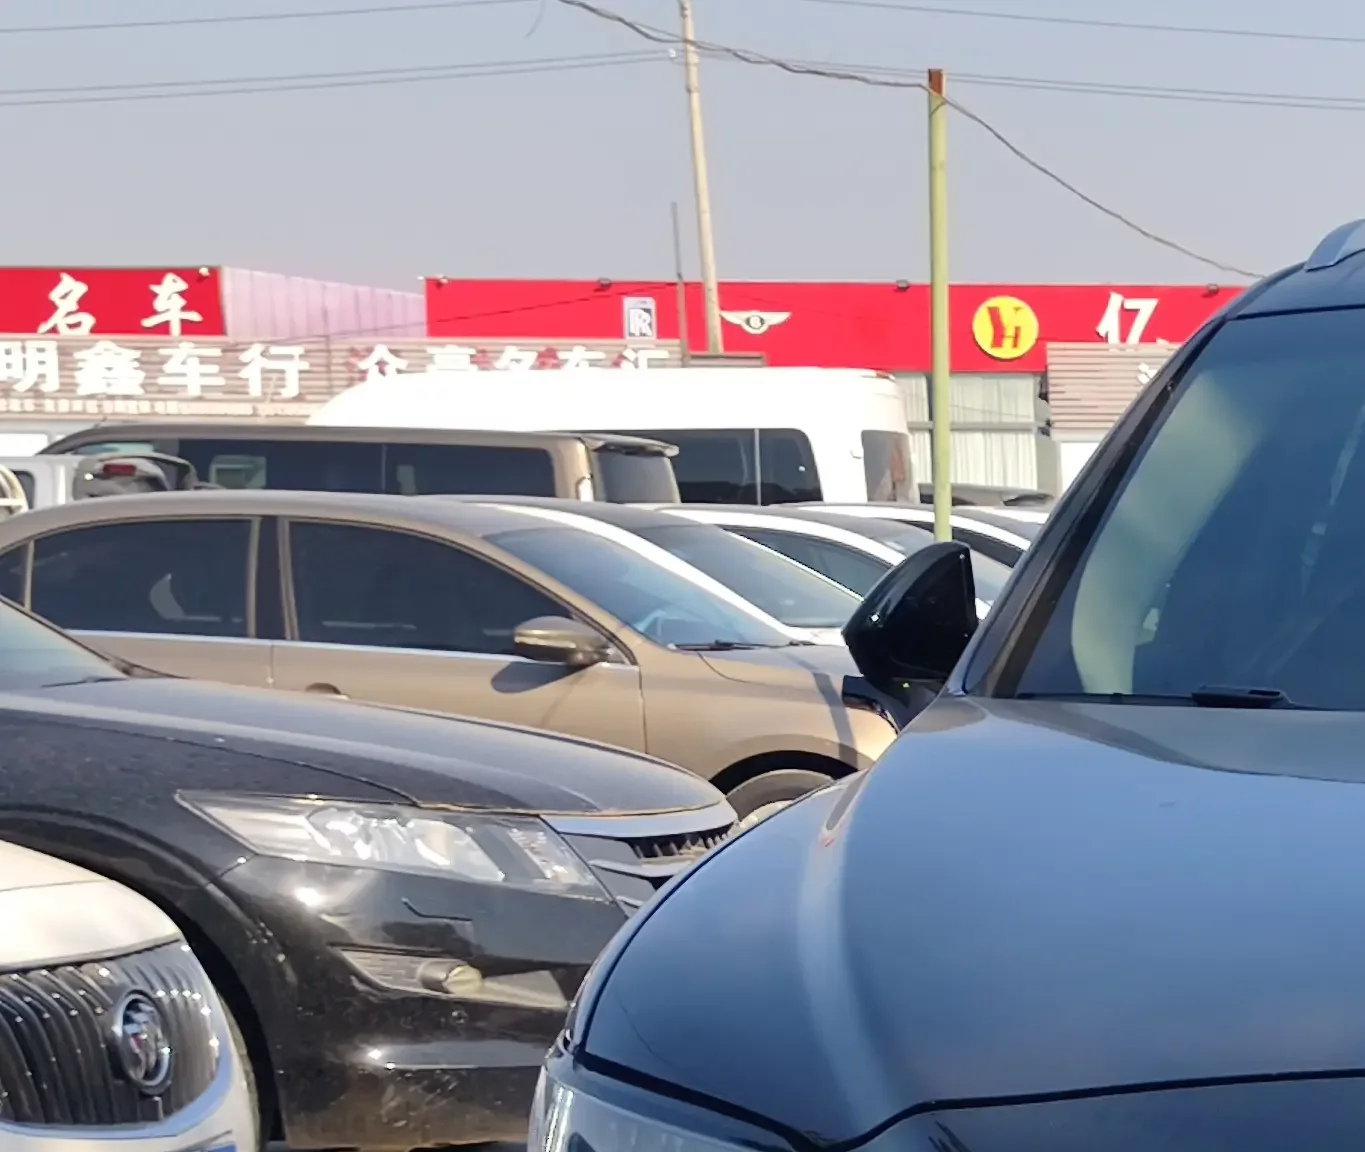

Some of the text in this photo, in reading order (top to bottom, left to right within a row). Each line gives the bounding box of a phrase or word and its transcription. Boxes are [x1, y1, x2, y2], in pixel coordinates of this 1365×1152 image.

[38, 273, 204, 336] 名车
[0, 340, 310, 397] 明鑫车行
